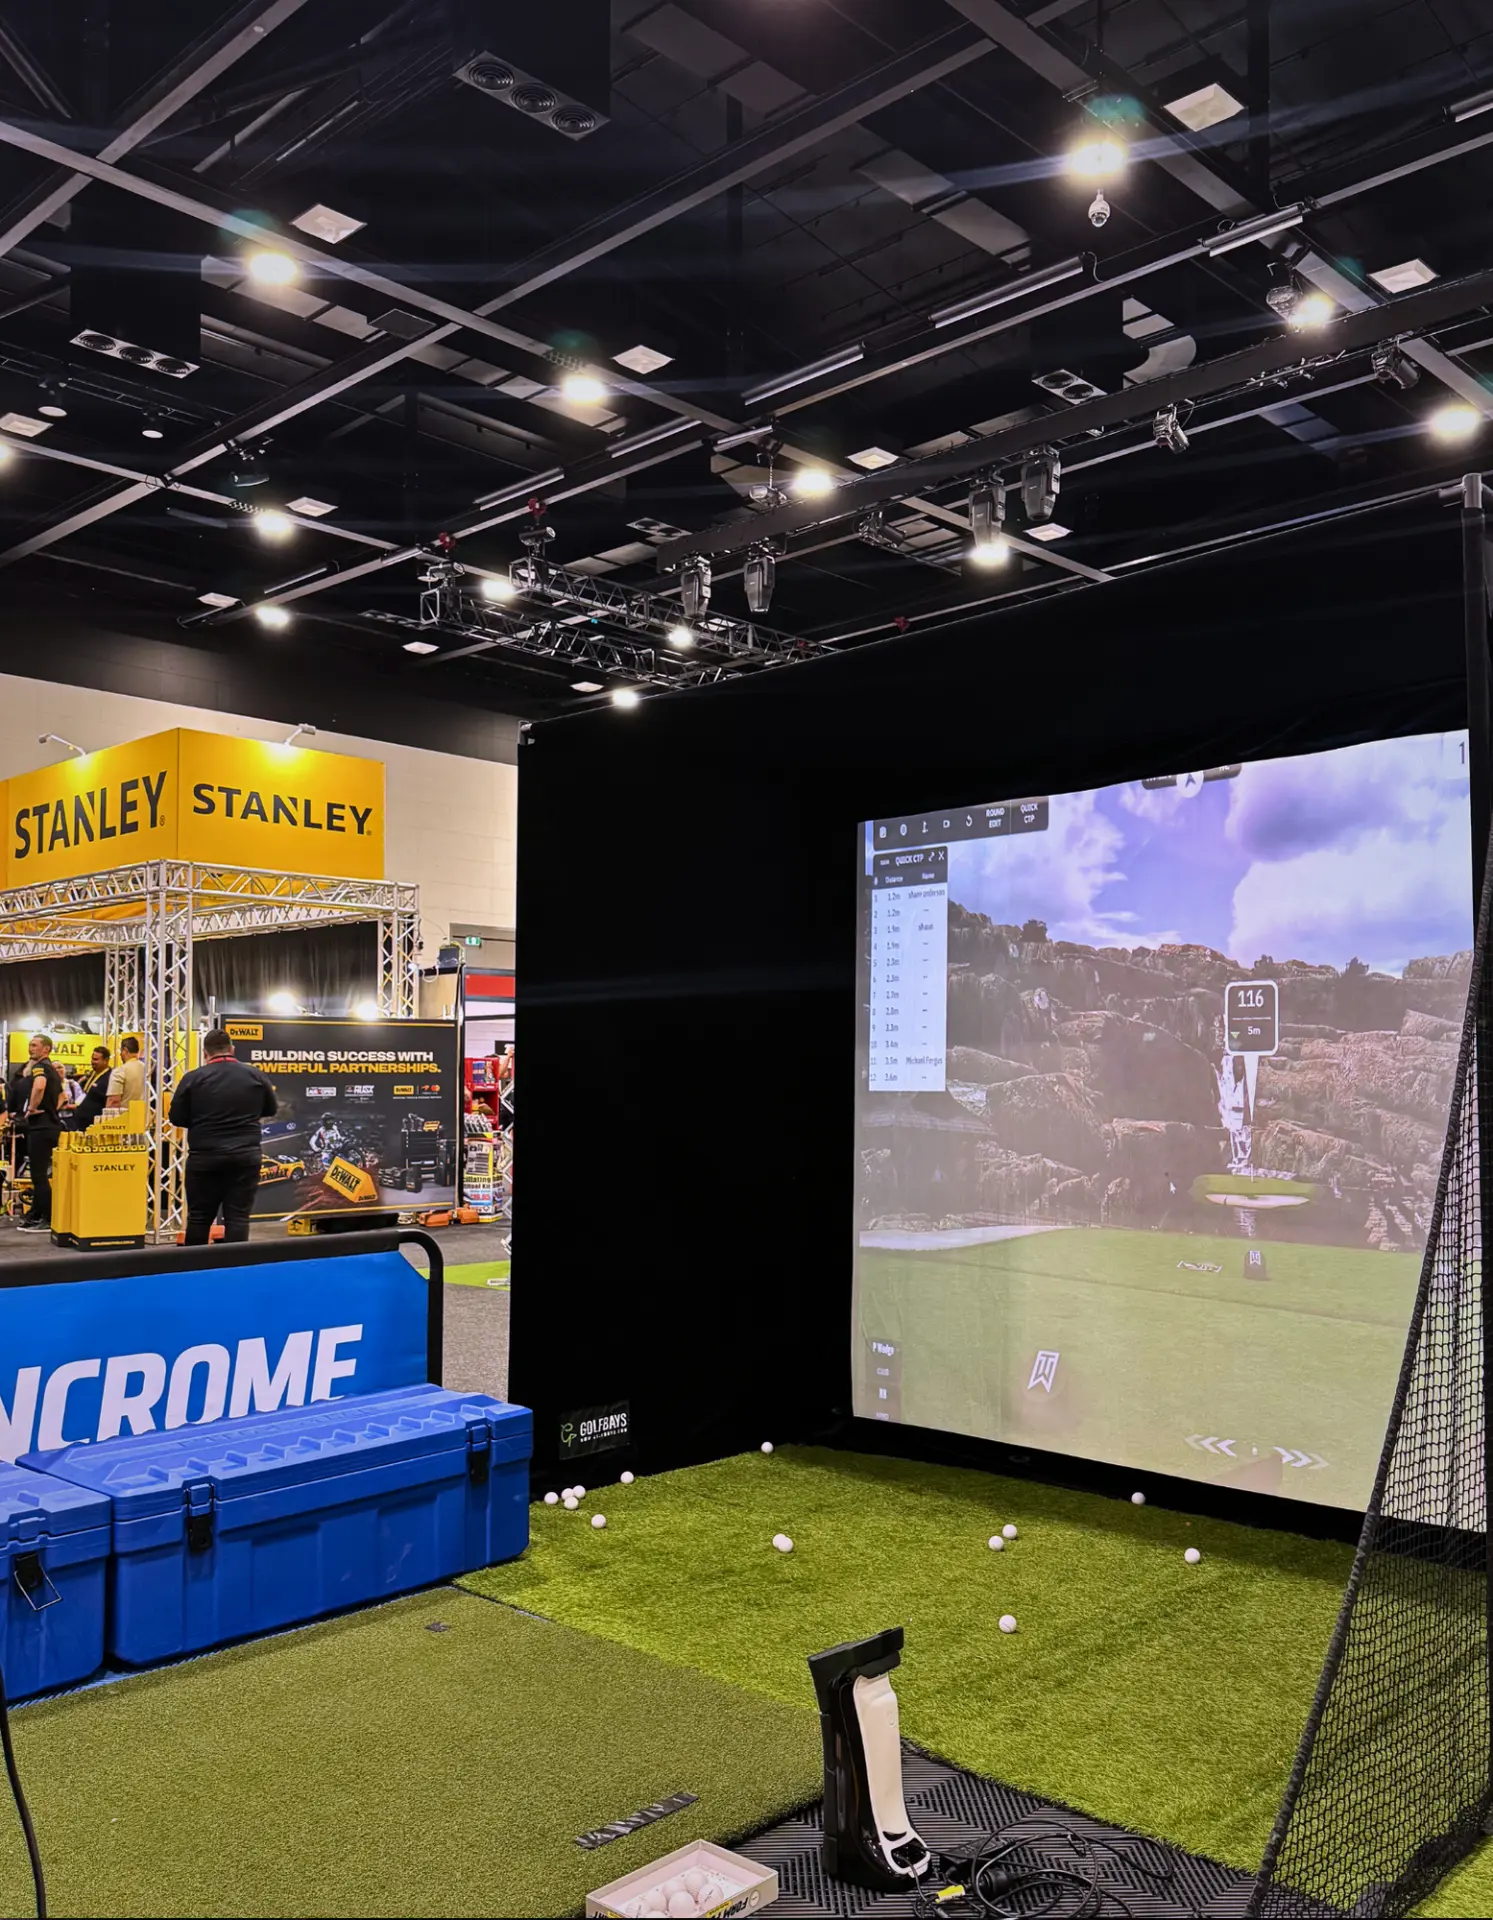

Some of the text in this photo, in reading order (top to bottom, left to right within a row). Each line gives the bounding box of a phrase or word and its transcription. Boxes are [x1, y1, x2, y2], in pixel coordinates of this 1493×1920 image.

[193, 783, 373, 835] STANLEY
[986, 807, 1005, 818] ROUND
[1020, 803, 1039, 813] QUICK
[14, 771, 168, 859] STANLEY
[1023, 814, 1035, 824] CTP
[988, 818, 1002, 828] EDIT
[895, 855, 912, 867] QUICK
[913, 853, 925, 864] CTP
[1237, 989, 1264, 1008] 116
[1247, 1026, 1261, 1035] 5m
[251, 1050, 433, 1062] BUILDING SUCCESS WITH
[330, 1063, 442, 1074] PARTNERSHIPS.
[93, 1164, 135, 1172] STANLEY
[580, 1413, 627, 1437] GOLFBAYS
